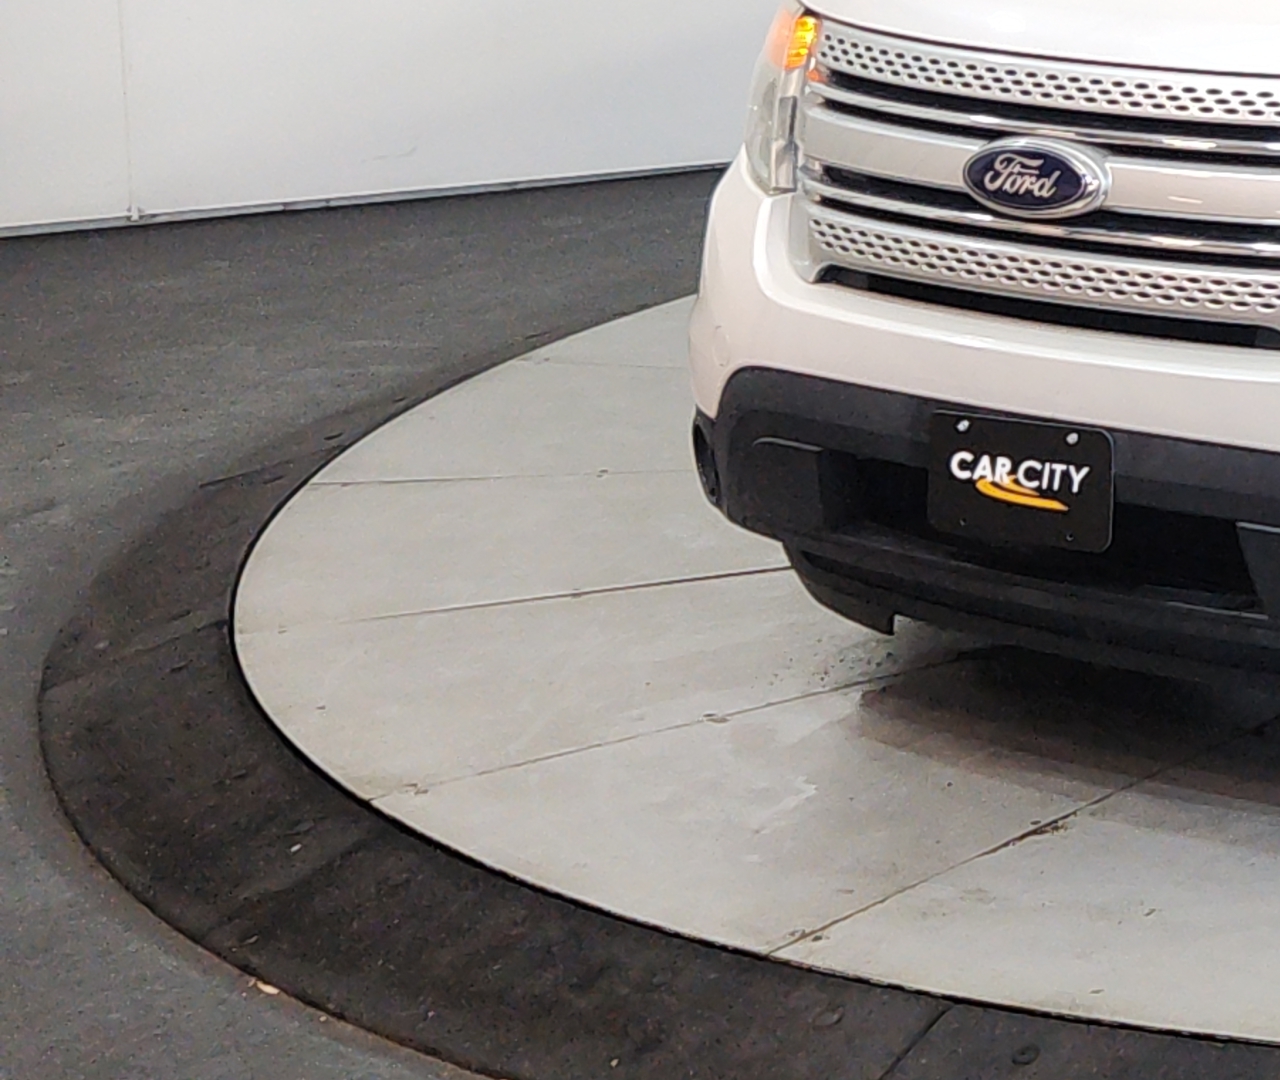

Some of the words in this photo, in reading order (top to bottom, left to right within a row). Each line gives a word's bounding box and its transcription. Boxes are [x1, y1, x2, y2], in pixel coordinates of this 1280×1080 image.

[983, 152, 1062, 199] Ford
[950, 450, 1012, 484] CAR
[1016, 459, 1091, 494] CITY
